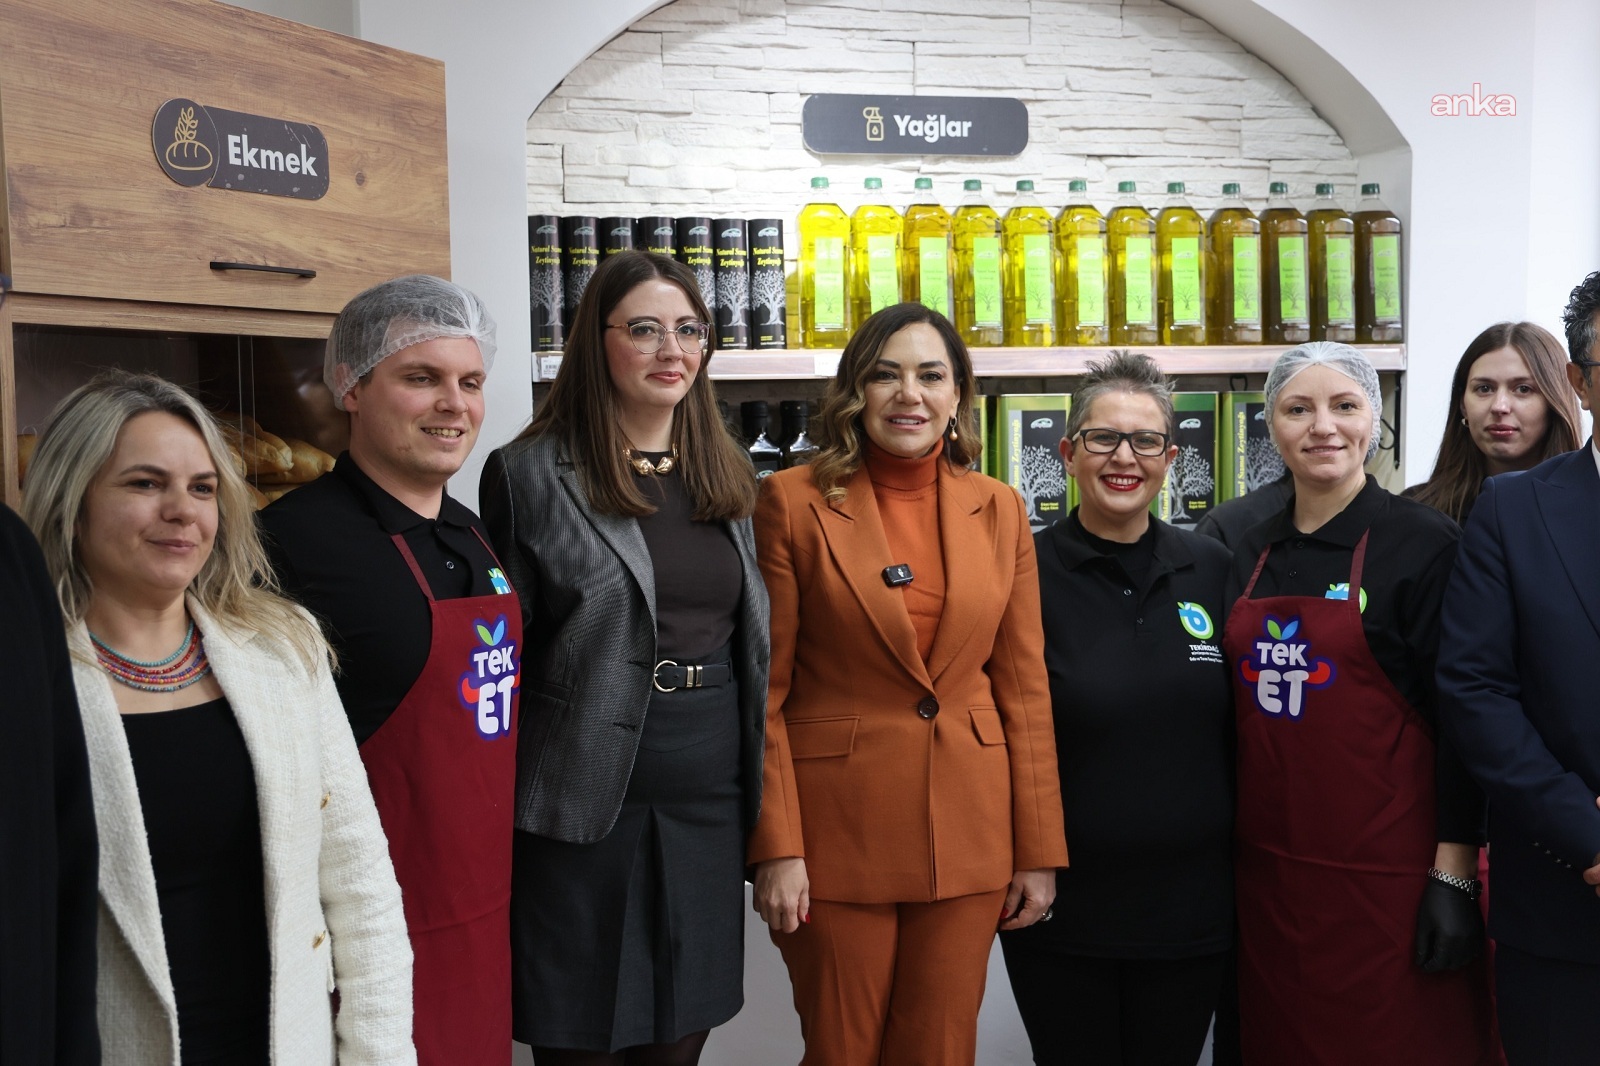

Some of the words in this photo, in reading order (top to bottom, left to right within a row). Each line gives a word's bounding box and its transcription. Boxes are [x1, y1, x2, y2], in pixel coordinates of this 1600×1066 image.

[893, 114, 972, 143] Yağlar
[227, 134, 318, 176] Ekmek
[478, 675, 515, 734] ET
[1257, 669, 1310, 717] ET
